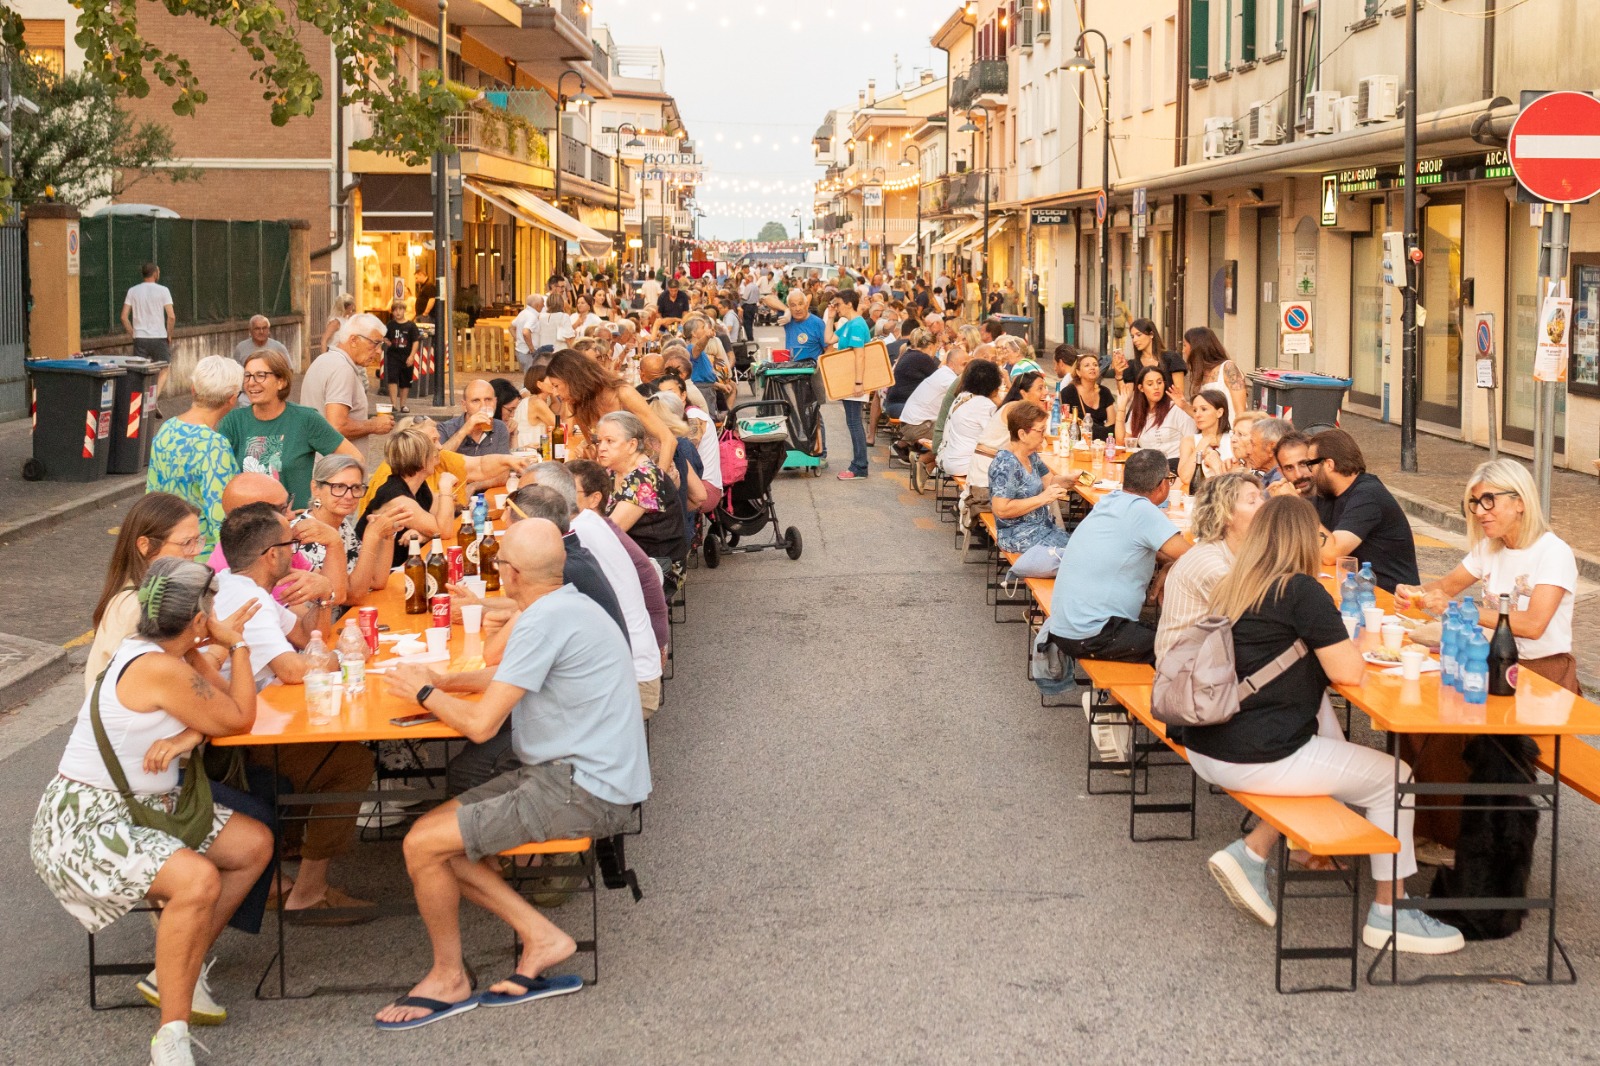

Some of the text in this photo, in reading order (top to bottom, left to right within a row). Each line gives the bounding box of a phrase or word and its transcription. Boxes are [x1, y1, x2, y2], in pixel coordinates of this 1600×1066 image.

[644, 153, 703, 164] HOTEL
[864, 192, 880, 200] CNA
[1037, 214, 1061, 224] jone
